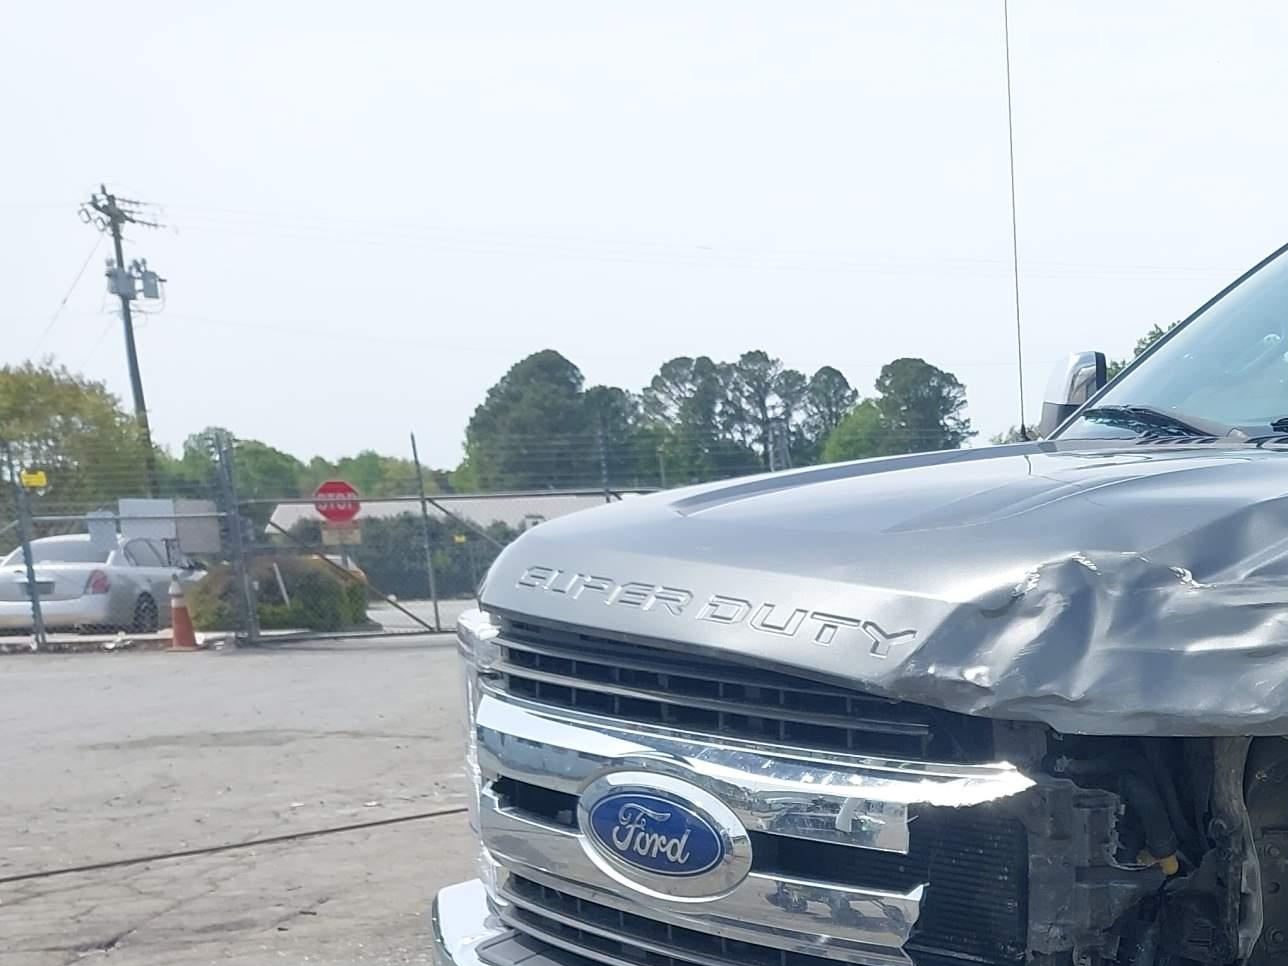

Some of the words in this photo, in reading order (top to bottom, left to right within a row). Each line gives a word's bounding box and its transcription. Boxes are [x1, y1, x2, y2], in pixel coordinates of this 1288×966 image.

[318, 492, 357, 511] STOP
[514, 564, 695, 616] SUPER
[695, 594, 918, 659] DUTY
[612, 802, 692, 864] Ford
